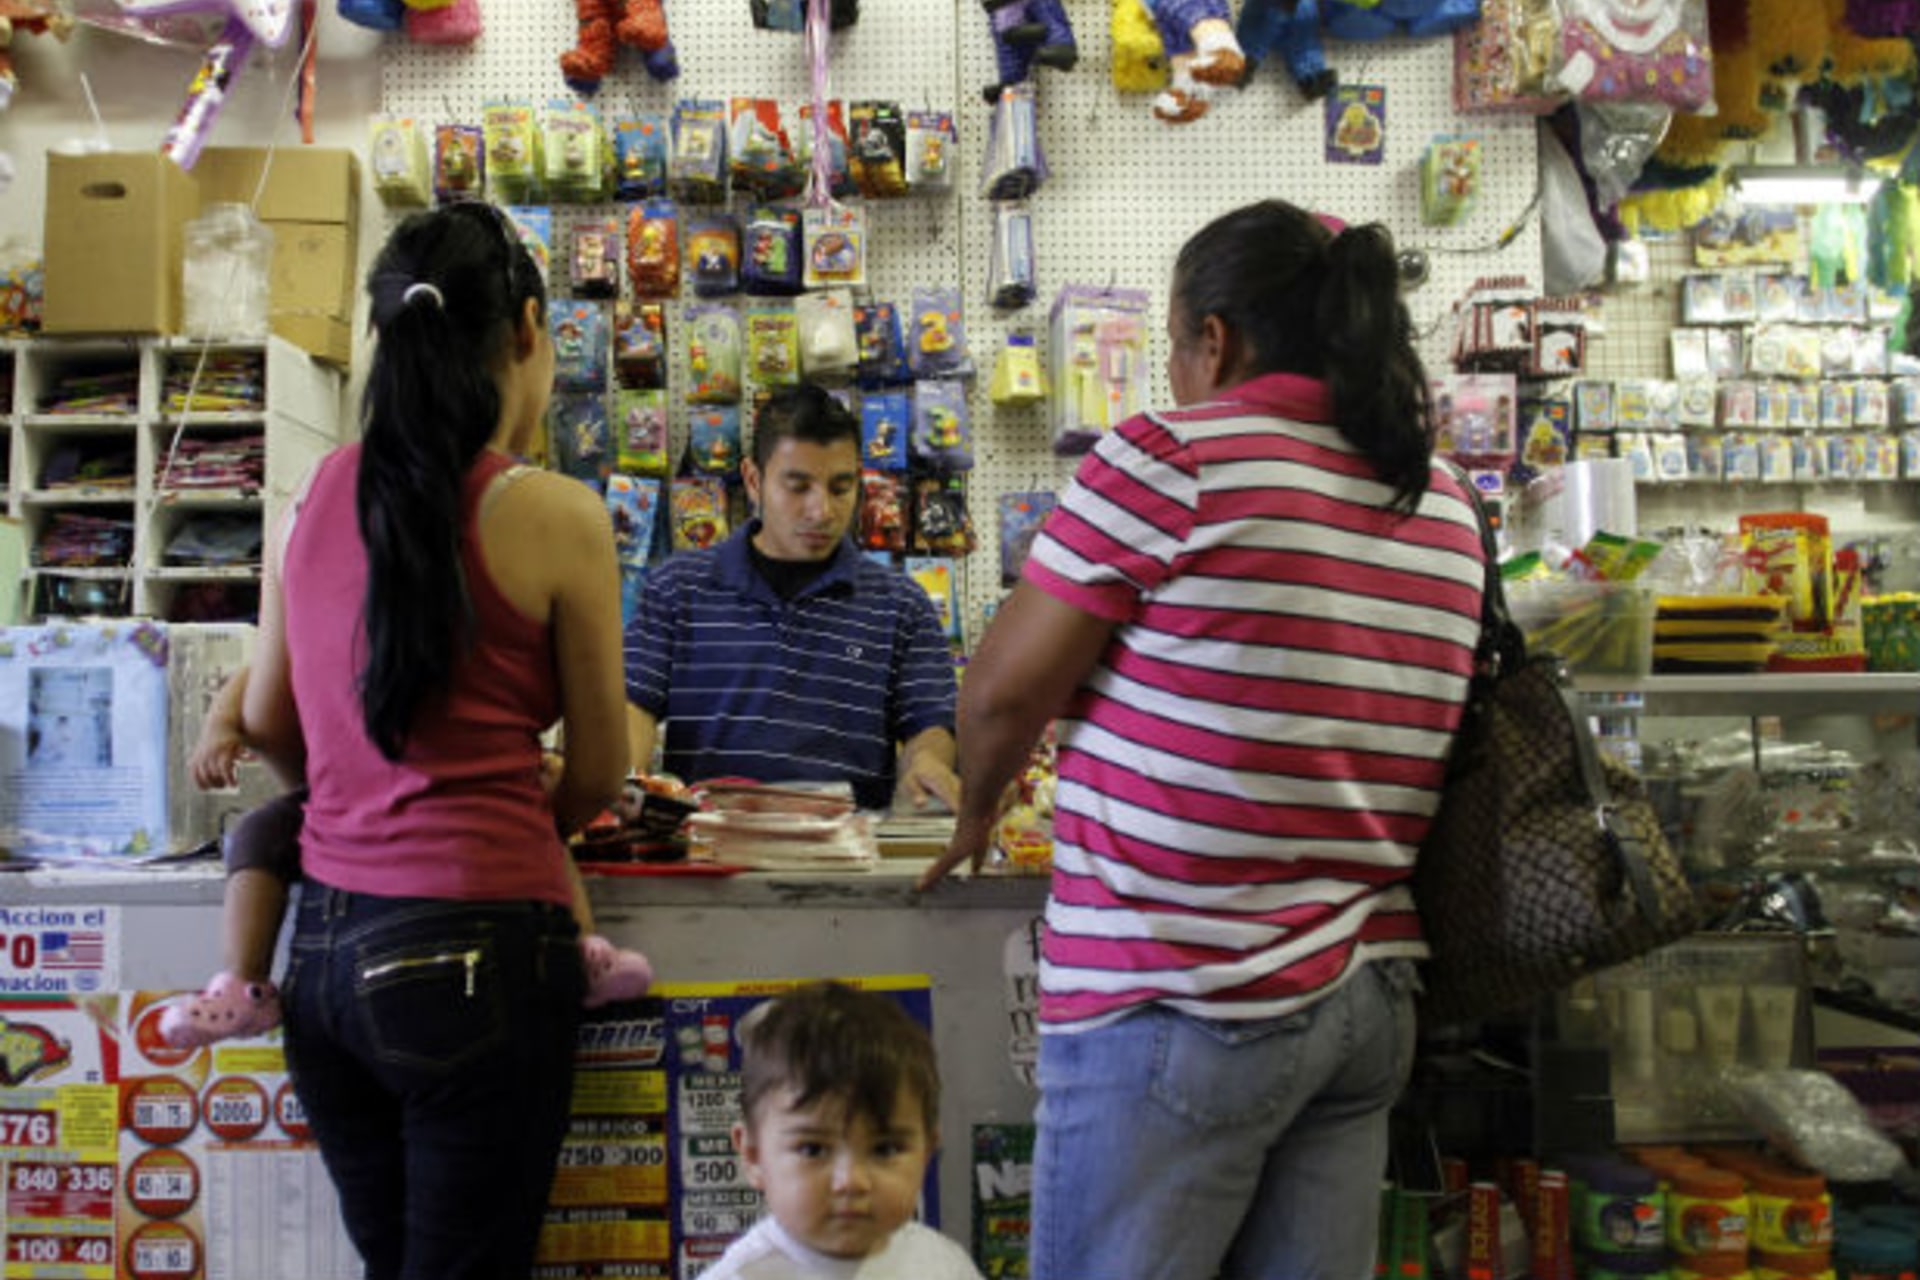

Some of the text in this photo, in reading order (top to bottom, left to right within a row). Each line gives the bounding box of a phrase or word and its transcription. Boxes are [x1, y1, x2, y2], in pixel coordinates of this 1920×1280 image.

[694, 1160, 737, 1183] 500
[19, 1239, 108, 1261] 100 40
